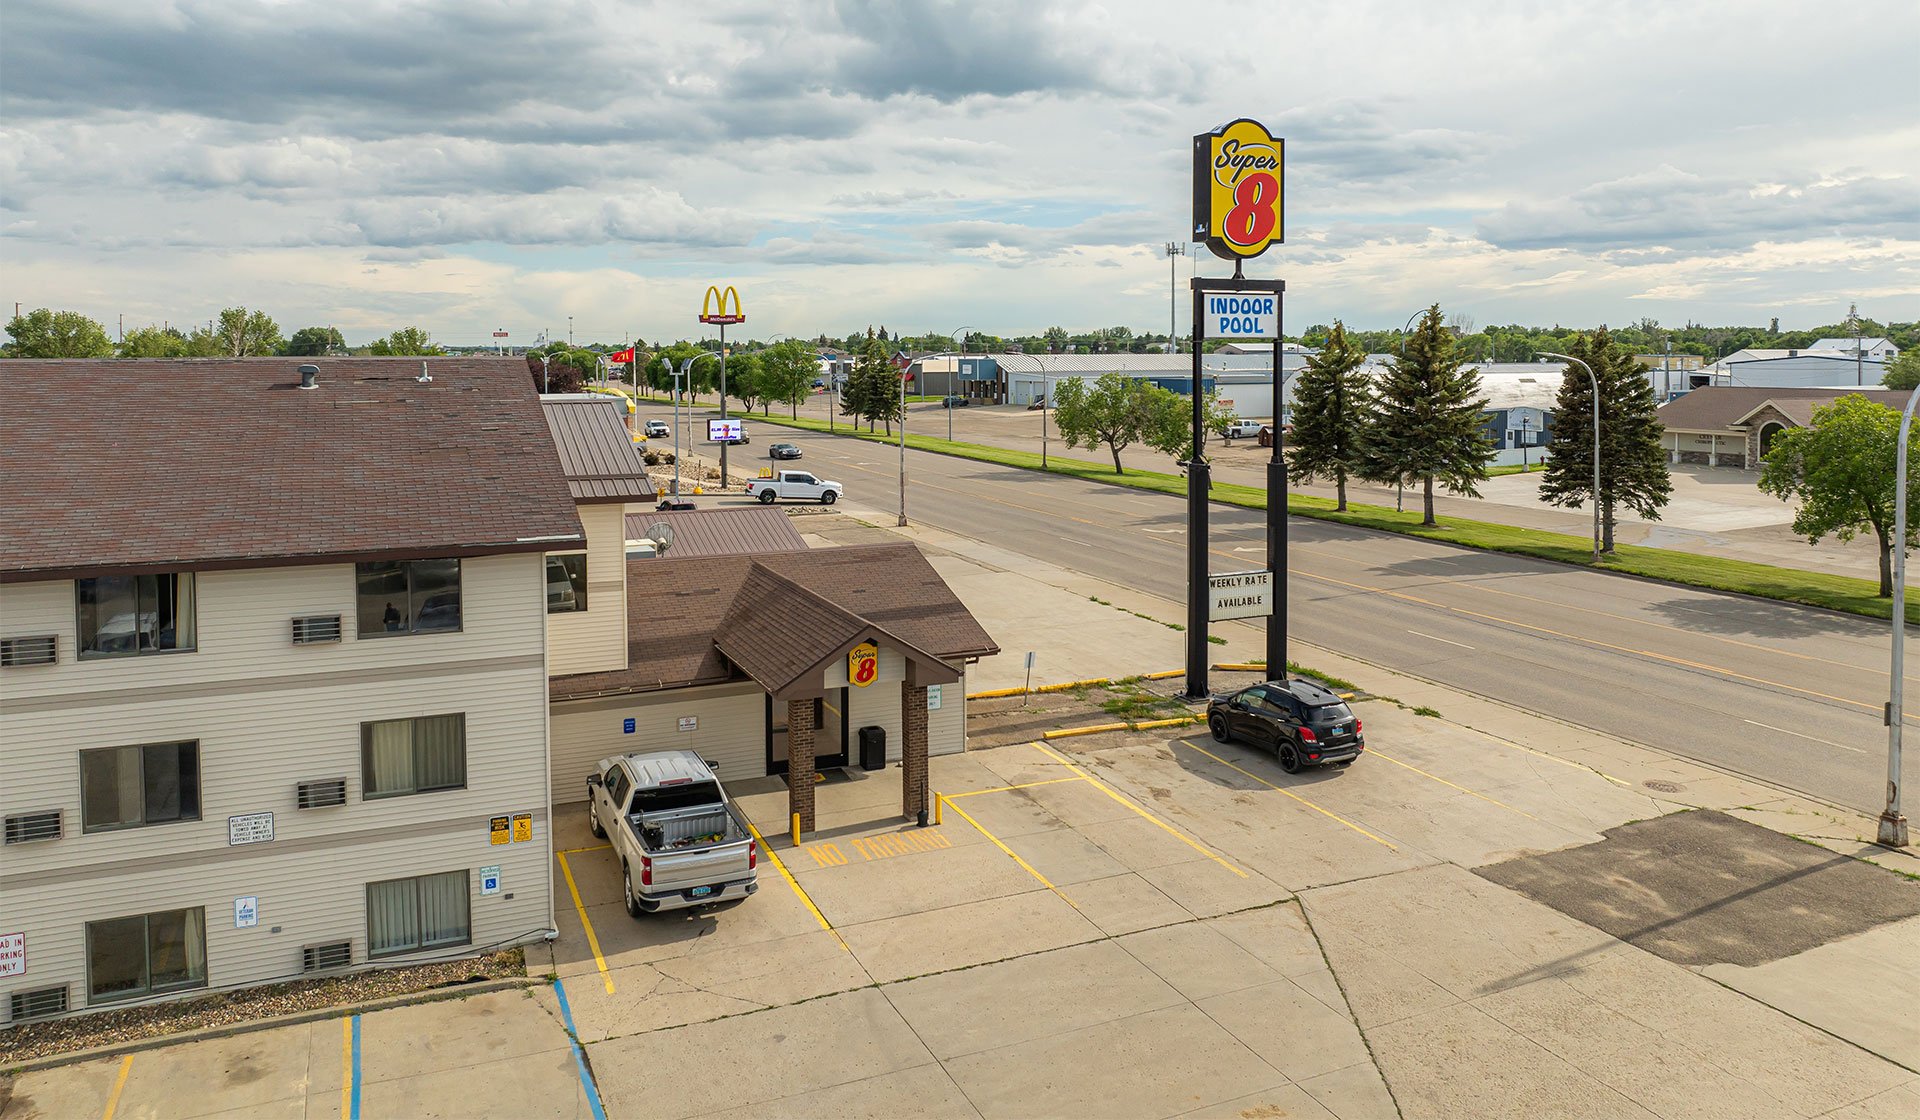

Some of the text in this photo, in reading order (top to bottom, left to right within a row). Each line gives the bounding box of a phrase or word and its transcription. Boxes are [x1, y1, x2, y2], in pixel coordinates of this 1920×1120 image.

[1215, 139, 1279, 184] Super
[1223, 172, 1279, 246] 8
[1210, 297, 1273, 315] INDOOR
[1219, 317, 1264, 334] POOL
[1210, 575, 1267, 588] WEEKLY RATE
[1217, 595, 1262, 608] AVAILABLE
[852, 649, 875, 663] Super
[855, 658, 876, 683] 8
[807, 828, 952, 868] NO PARKING
[0, 938, 22, 948] AD IN
[0, 949, 22, 961] RKING
